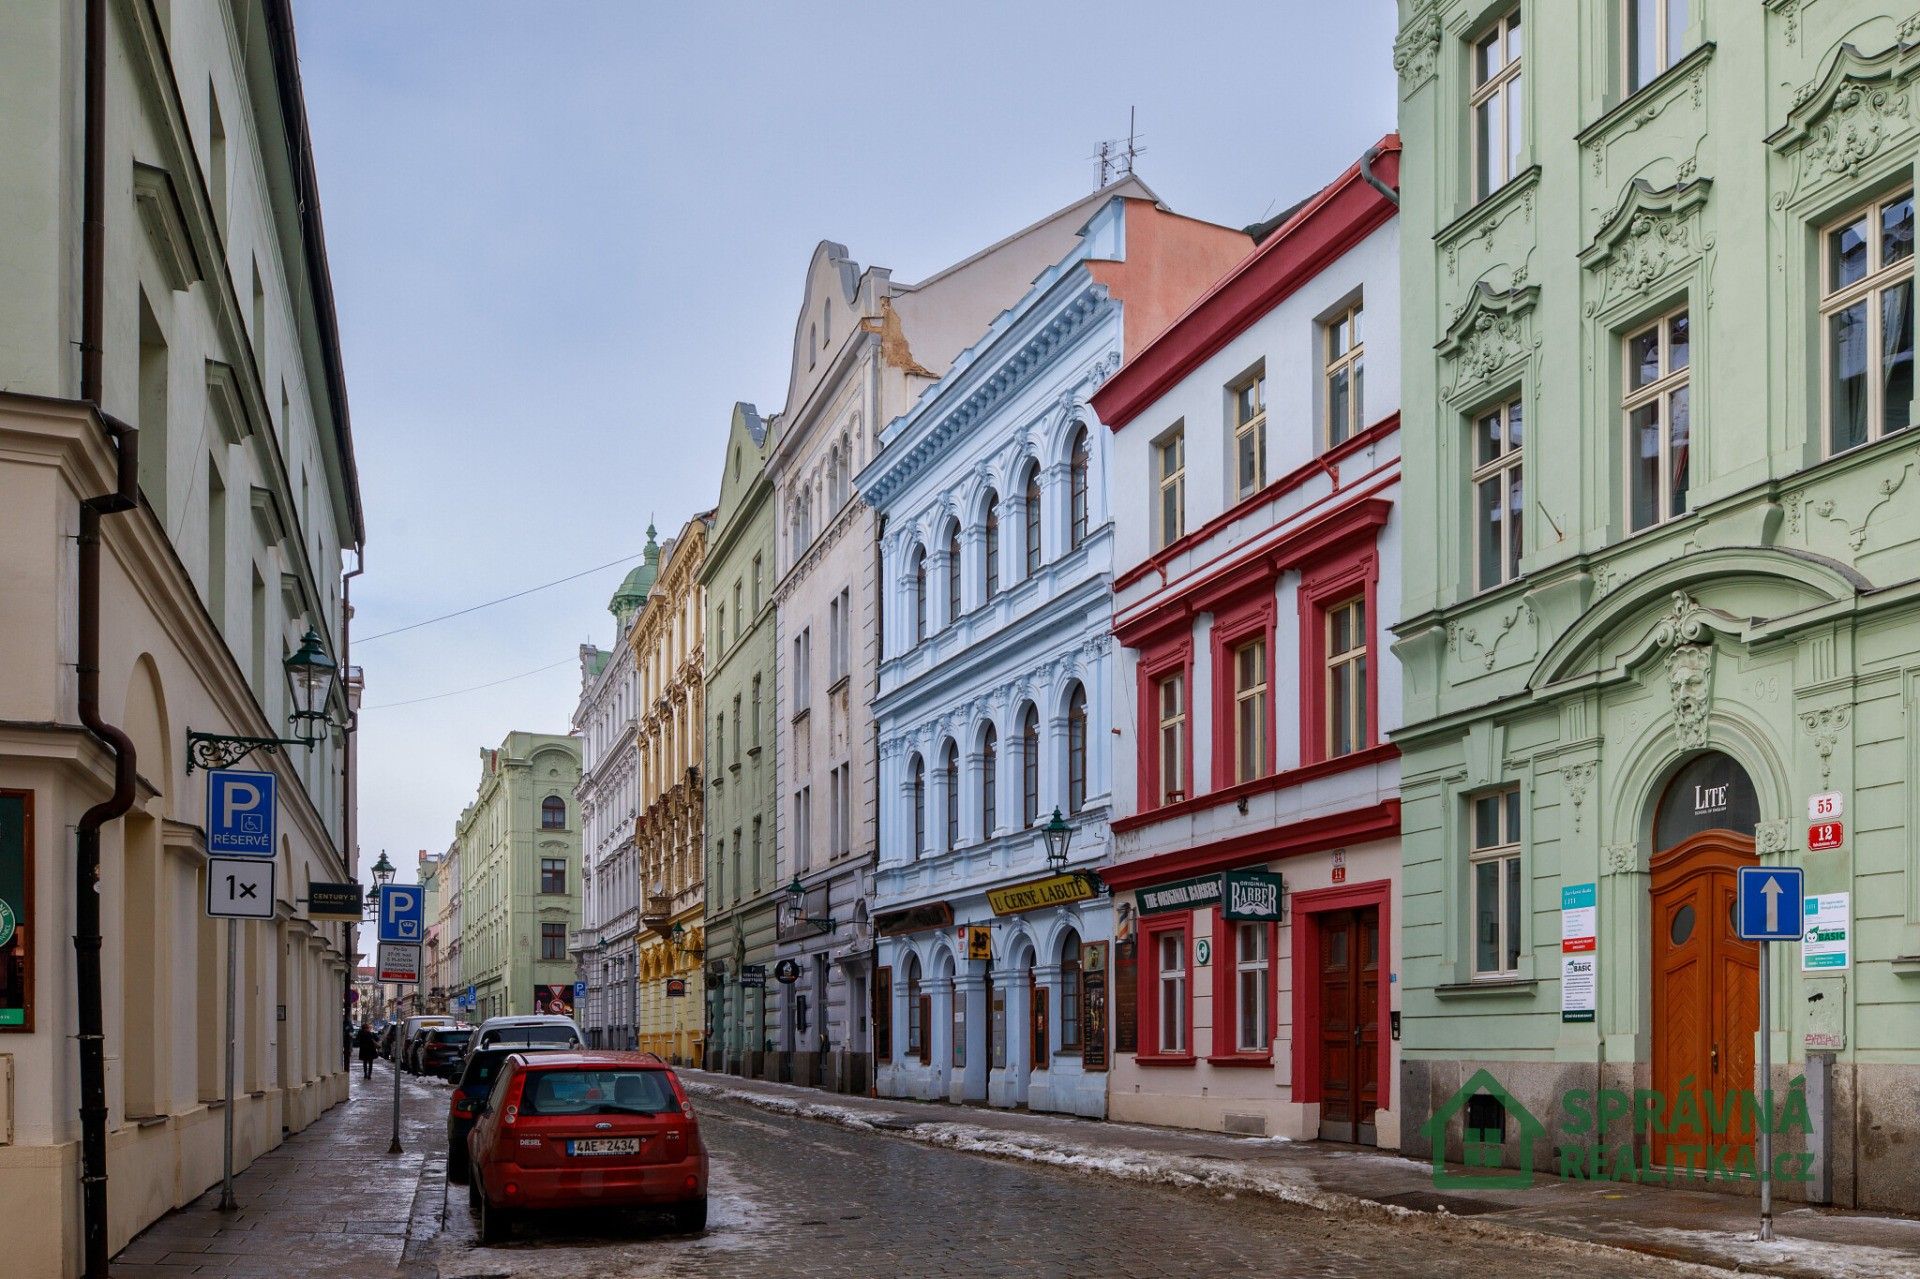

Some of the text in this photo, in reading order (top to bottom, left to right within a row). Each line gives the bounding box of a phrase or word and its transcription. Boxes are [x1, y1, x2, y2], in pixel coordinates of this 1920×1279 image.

[223, 781, 261, 828] P
[1694, 784, 1728, 811] LITE
[1817, 798, 1833, 814] 55
[213, 832, 270, 846] RÉSERVÉ
[1818, 825, 1833, 841] 12
[388, 891, 414, 924] P
[994, 896, 1003, 911] U
[1004, 885, 1039, 910] ČERNÉ
[1144, 892, 1159, 909] THE
[1157, 887, 1190, 906] ORIGINAL
[1188, 881, 1220, 901] BARBER
[1231, 882, 1277, 914] BARBER
[1818, 931, 1846, 941] BASIC
[577, 1140, 634, 1152] 4AE 2434
